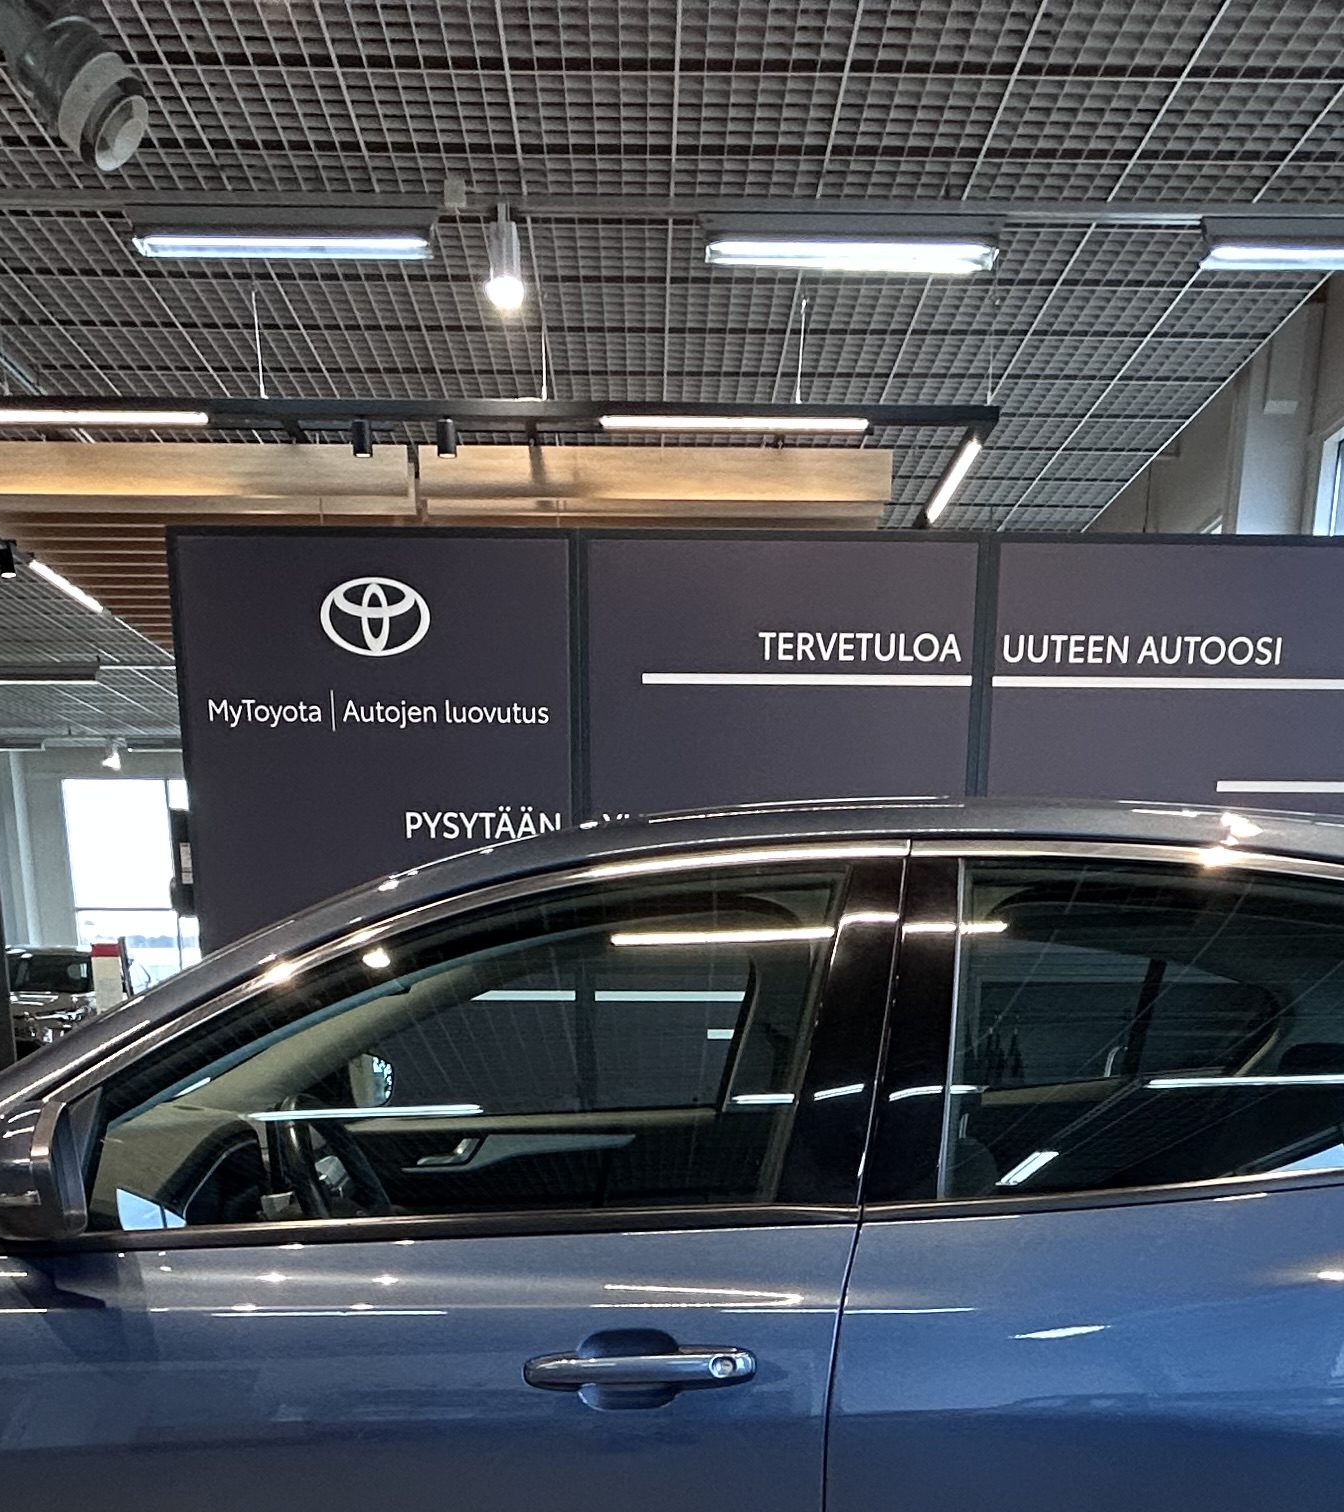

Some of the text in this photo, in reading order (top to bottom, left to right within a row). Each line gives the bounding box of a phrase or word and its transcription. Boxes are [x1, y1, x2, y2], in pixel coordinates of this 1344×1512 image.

[758, 631, 1284, 666] TERVETULOA UUTEEN AUTOOSI
[208, 698, 550, 729] MyToyota Autojen luovutus
[405, 805, 561, 840] PYSYTÄÄN
